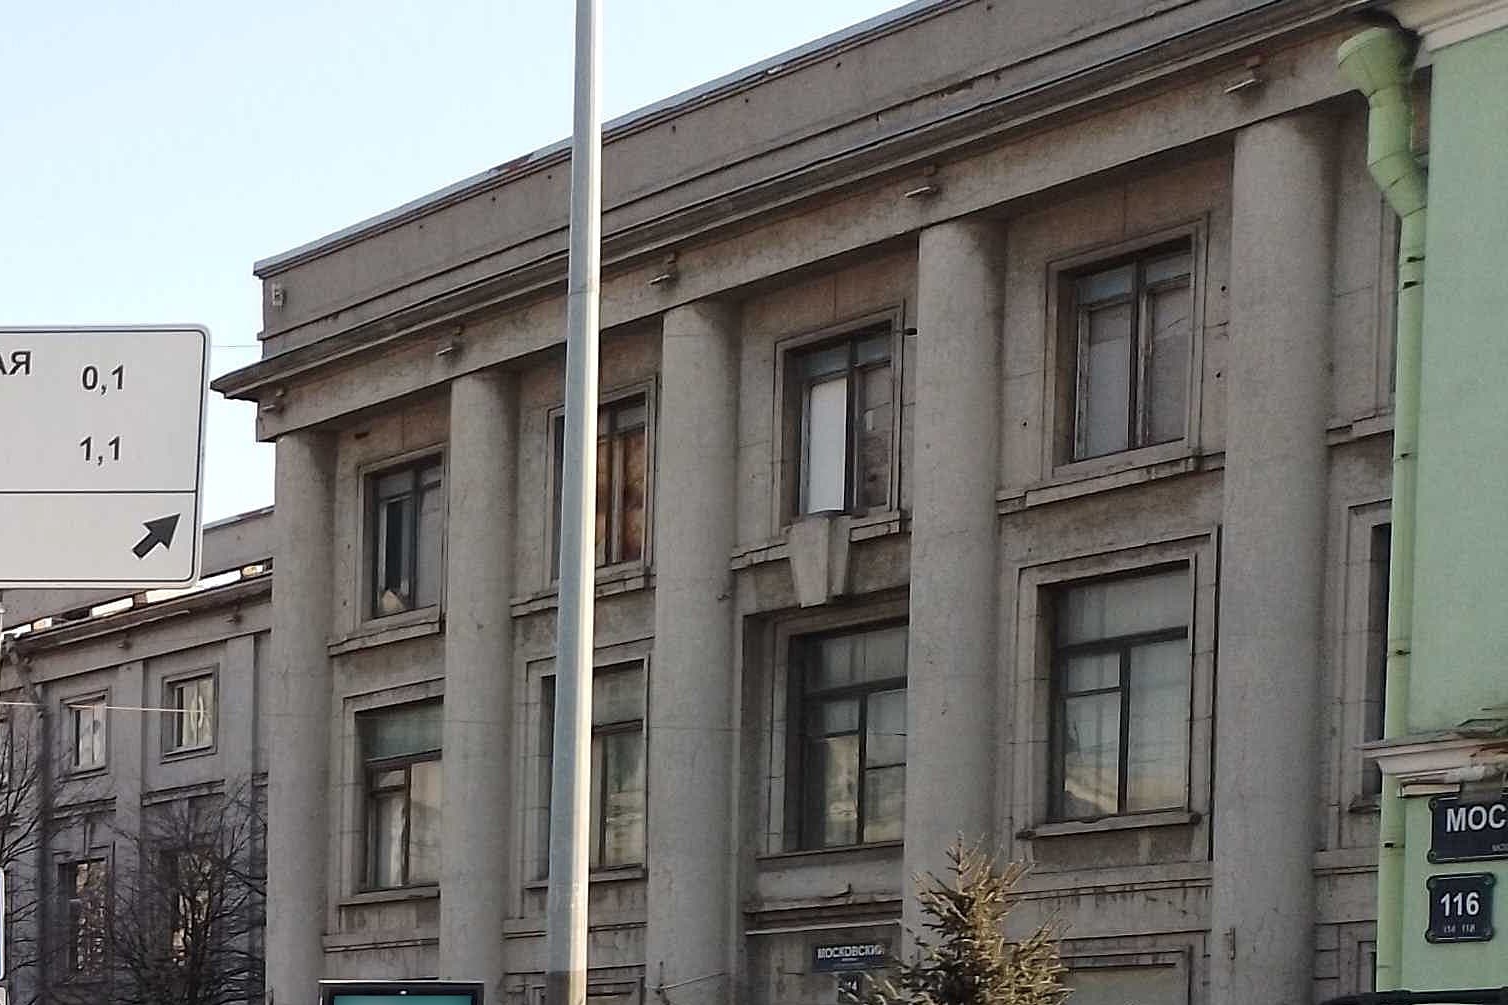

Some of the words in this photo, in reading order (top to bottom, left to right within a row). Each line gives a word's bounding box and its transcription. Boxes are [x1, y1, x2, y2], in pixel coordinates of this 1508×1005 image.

[81, 364, 126, 395] 0,1
[80, 436, 122, 467] 1,1
[1440, 892, 1480, 917] 116
